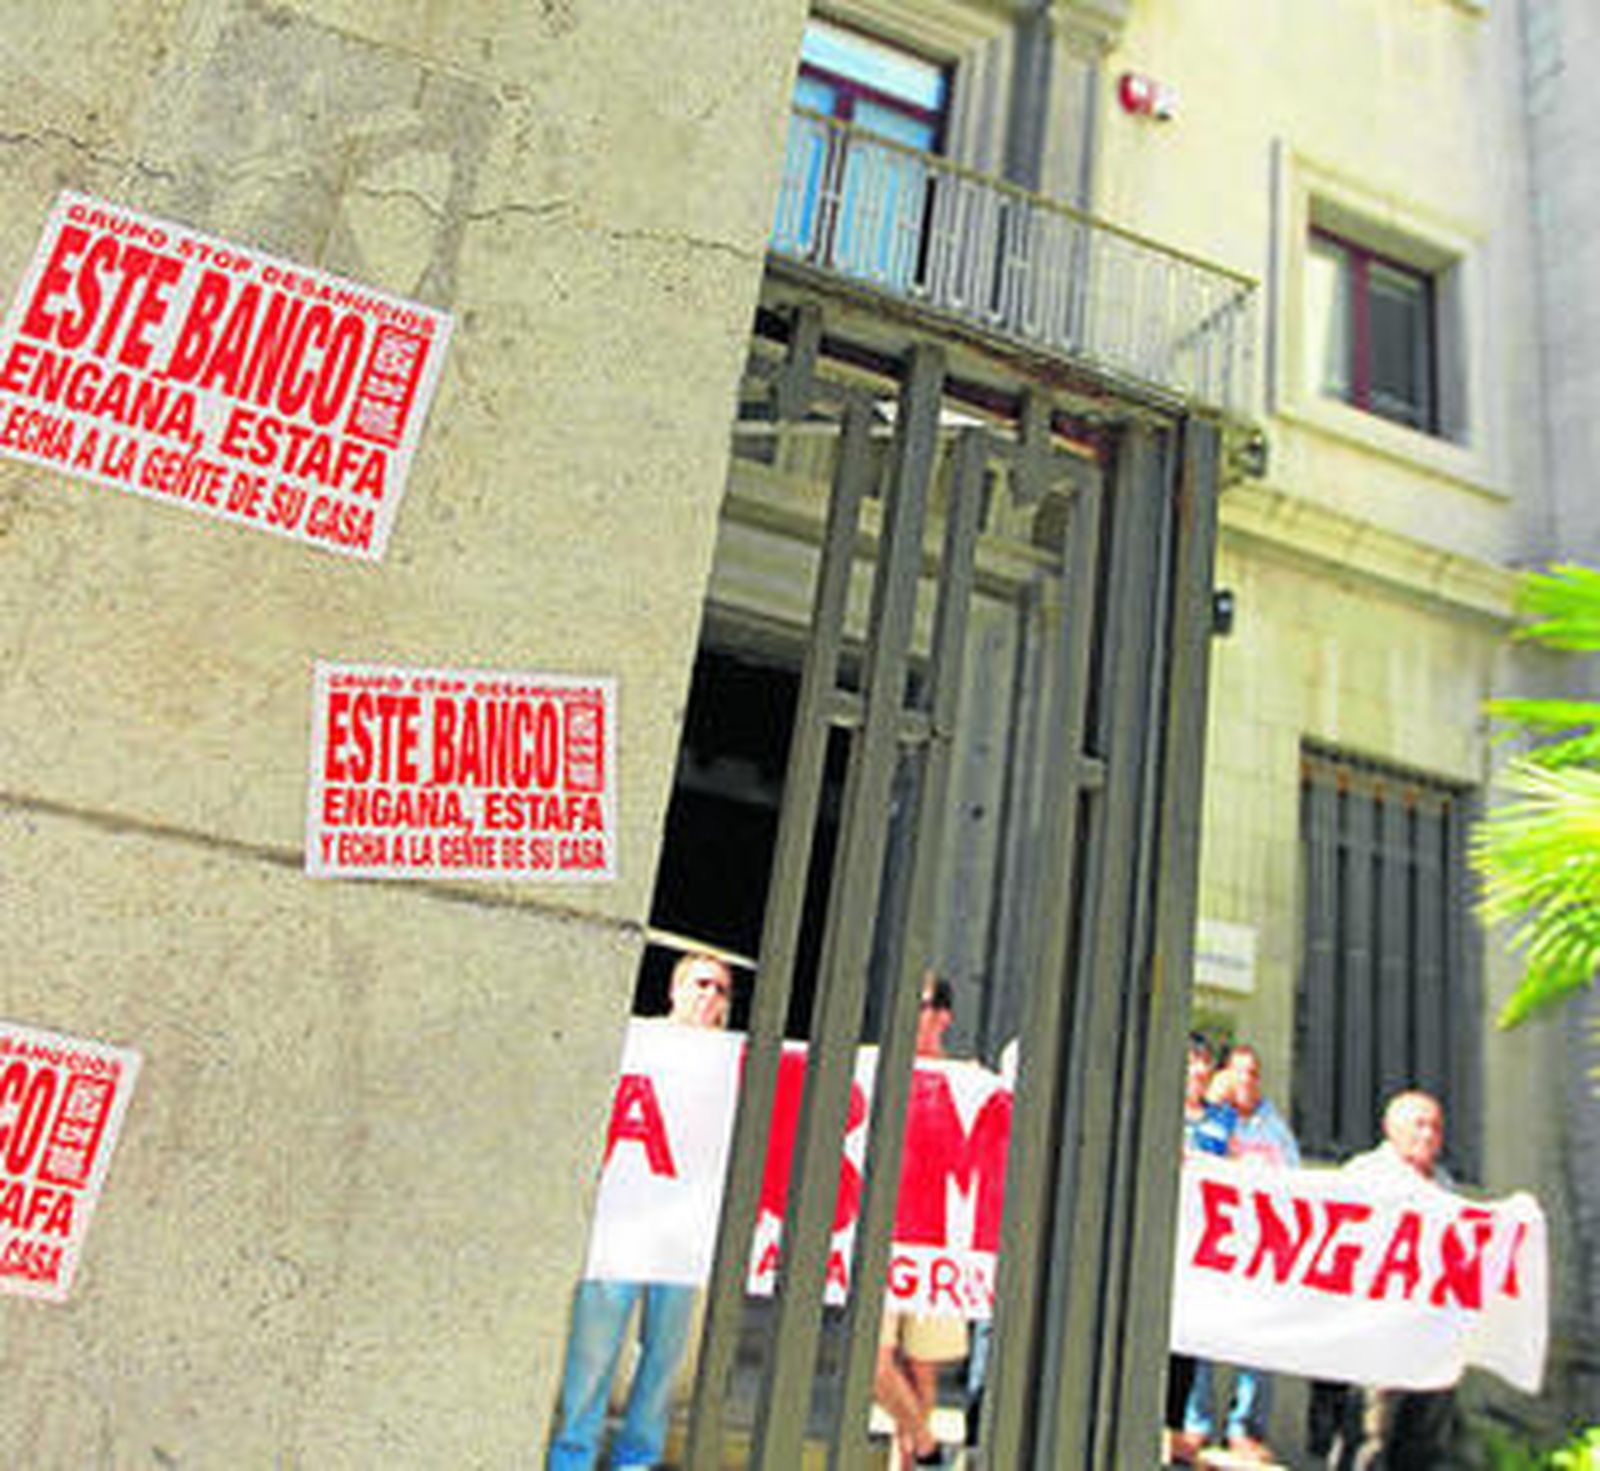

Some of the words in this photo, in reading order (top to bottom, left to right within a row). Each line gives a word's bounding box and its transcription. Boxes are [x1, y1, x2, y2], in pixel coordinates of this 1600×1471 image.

[19, 224, 185, 369] ESTE
[168, 269, 366, 426] BANCO
[73, 428, 98, 470] A
[101, 433, 138, 482] LA
[139, 446, 228, 506] GENTE
[226, 471, 268, 518] DE
[265, 482, 309, 531] SU
[305, 495, 375, 551] CASA
[220, 407, 388, 499] ESTAFA
[324, 692, 421, 784] ESTE
[430, 695, 559, 790] BANCO
[320, 831, 334, 865] Y
[391, 834, 406, 867] A
[409, 834, 434, 867] LA
[501, 836, 526, 870] DE
[559, 838, 607, 870] CASA
[483, 792, 604, 833] ESTAFA
[0, 1180, 74, 1238] AFA
